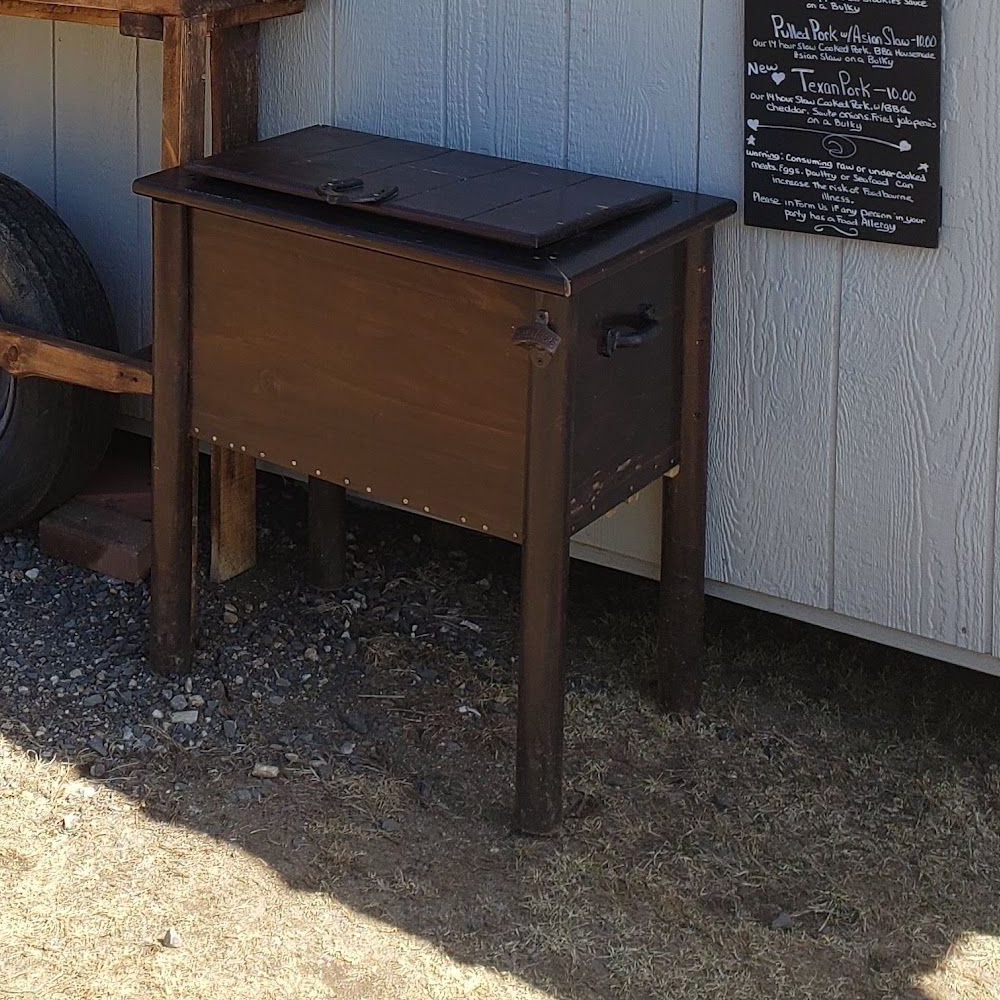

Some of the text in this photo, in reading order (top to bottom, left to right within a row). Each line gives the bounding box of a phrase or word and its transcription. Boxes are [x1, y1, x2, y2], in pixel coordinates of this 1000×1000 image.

[830, 3, 860, 13] Bulky
[771, 14, 810, 40] Pulled
[809, 18, 838, 41] Pork
[778, 40, 796, 49] hour
[797, 43, 816, 51] Slow
[819, 43, 849, 52] Cooked
[820, 53, 842, 61] Slaw
[748, 62, 778, 75] New
[791, 68, 871, 98] Texan Pork
[795, 96, 815, 104] Slow
[817, 98, 849, 108] Cooked
[835, 119, 862, 131] Bulky
[786, 154, 833, 168] Consuming
[772, 174, 810, 188] increase
[829, 184, 848, 193] risk
[853, 175, 889, 186] Seafood
[753, 192, 781, 205] Please
[841, 207, 857, 216] any
[861, 219, 896, 233] Allergy
